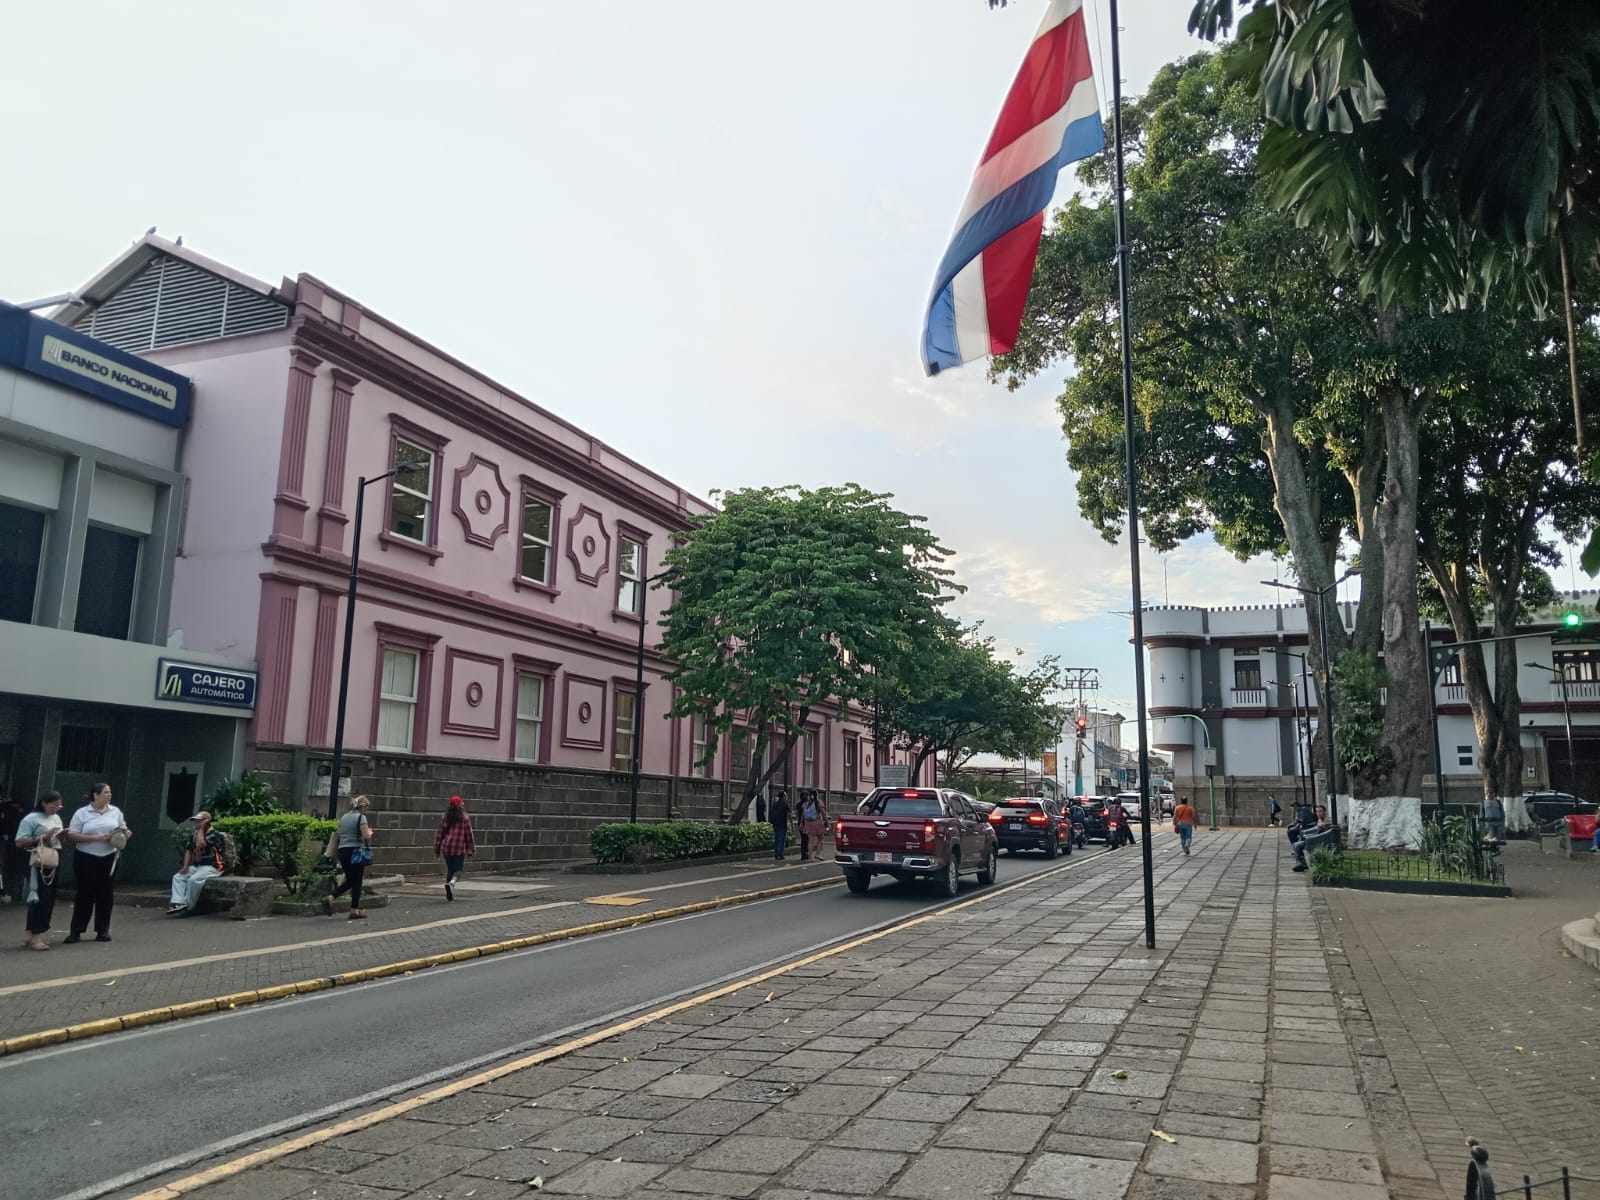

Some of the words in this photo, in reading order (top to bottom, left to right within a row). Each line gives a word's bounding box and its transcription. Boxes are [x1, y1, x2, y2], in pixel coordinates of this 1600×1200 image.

[61, 350, 109, 376] BANCO
[111, 370, 172, 402] NACIONAL
[192, 673, 246, 690] CAJERO
[190, 687, 245, 700] AUTOMÁTICO
